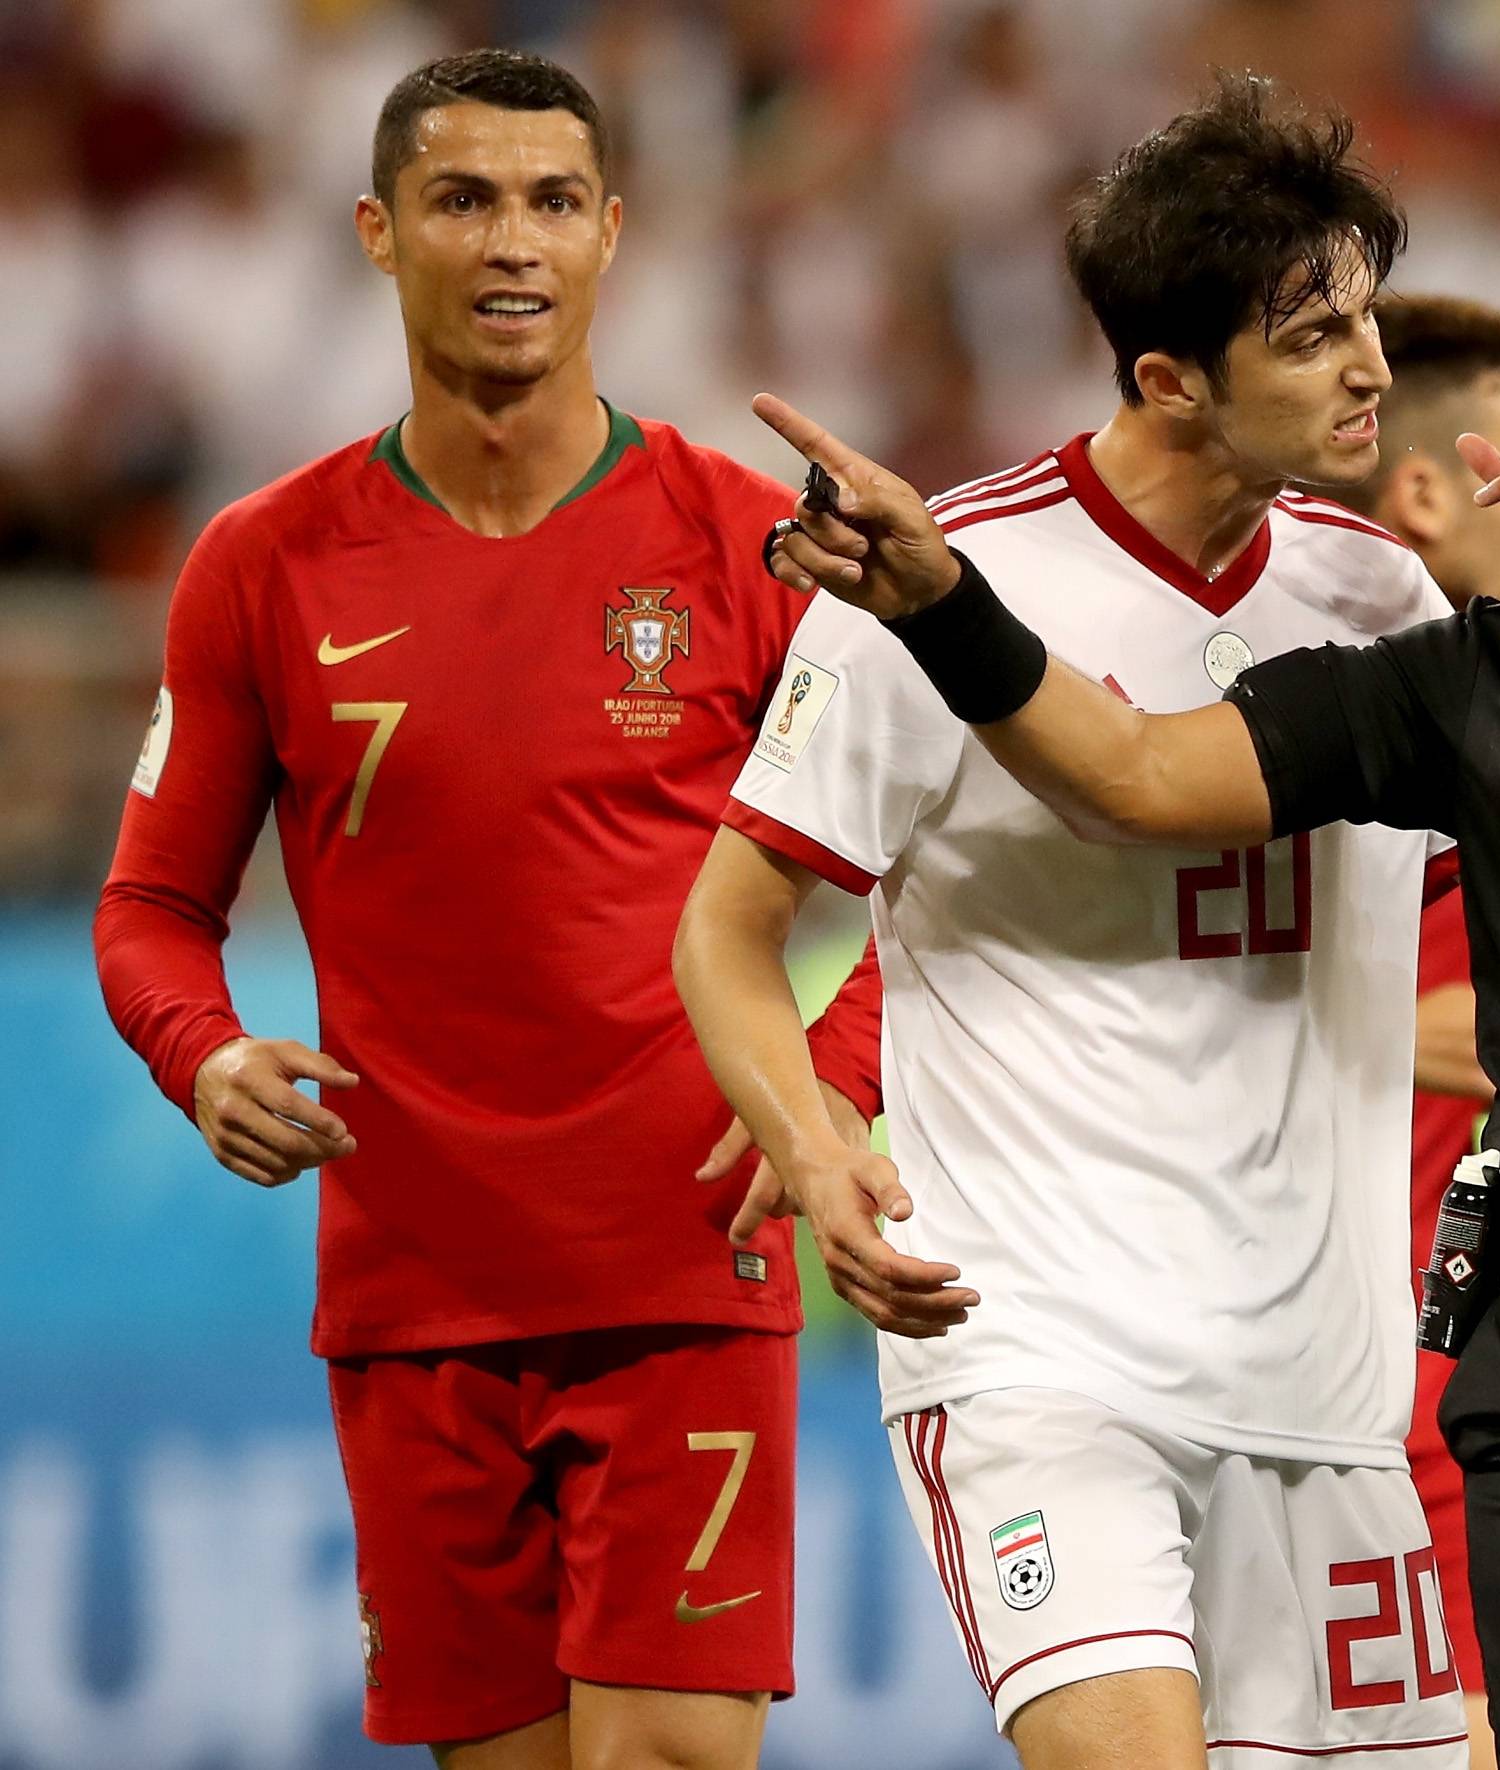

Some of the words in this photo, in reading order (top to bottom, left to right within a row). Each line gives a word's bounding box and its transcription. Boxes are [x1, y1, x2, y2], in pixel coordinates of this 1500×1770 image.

[331, 701, 408, 837] 7
[610, 712, 623, 724] 25
[623, 725, 669, 737] SARANSK
[1176, 832, 1311, 960] 20
[686, 1432, 756, 1571] 7
[1326, 1546, 1459, 1710] 20
